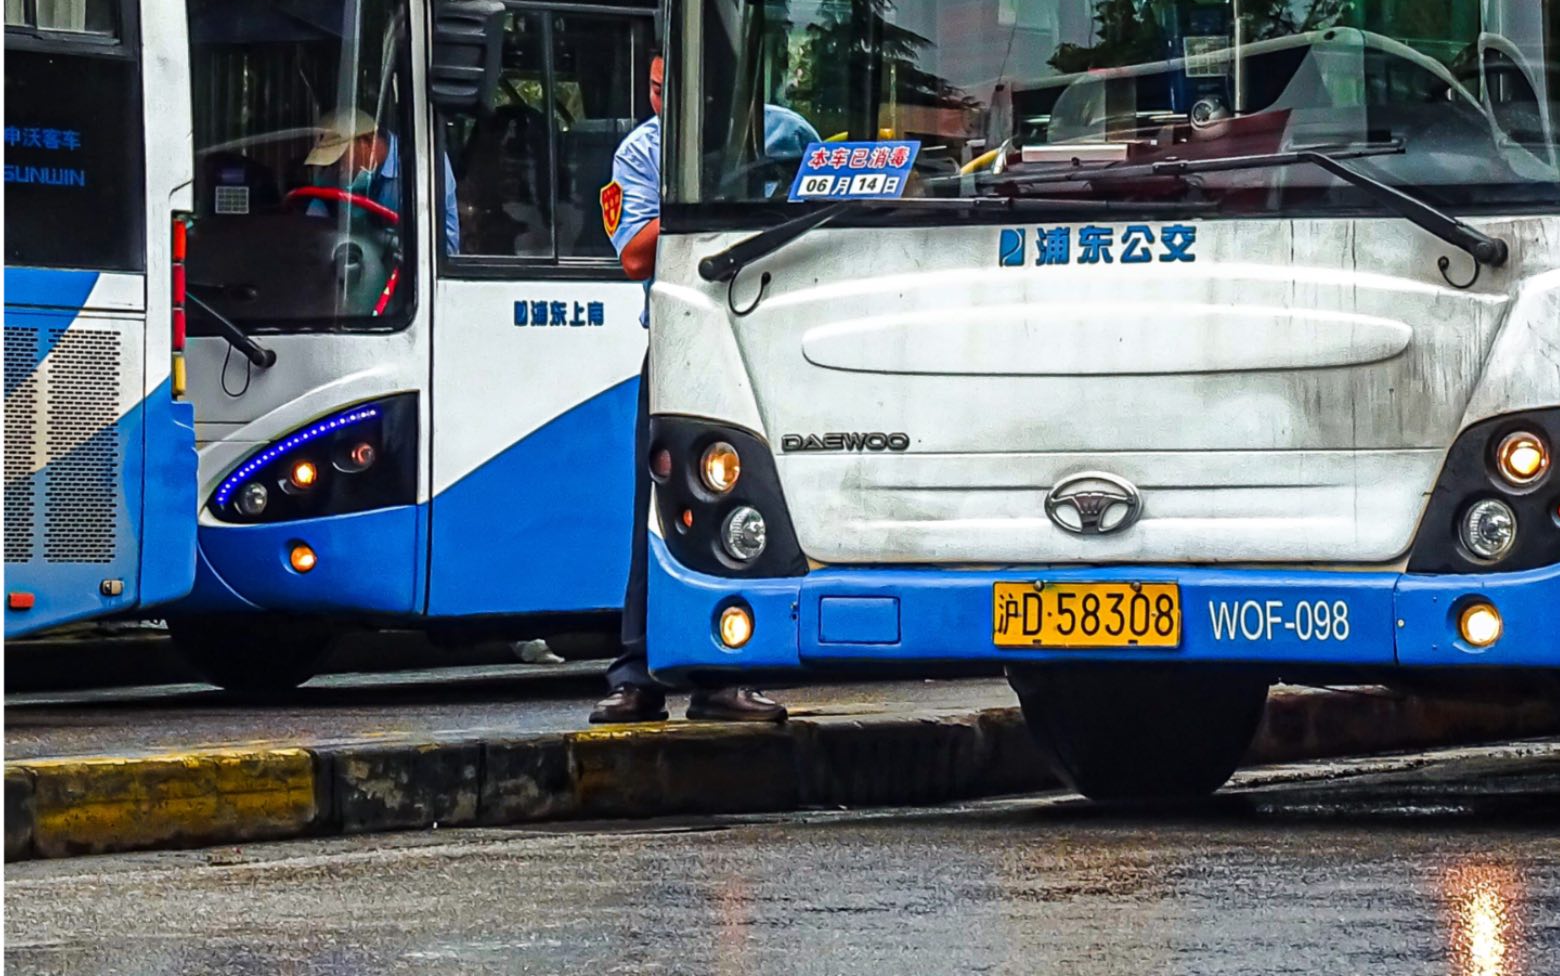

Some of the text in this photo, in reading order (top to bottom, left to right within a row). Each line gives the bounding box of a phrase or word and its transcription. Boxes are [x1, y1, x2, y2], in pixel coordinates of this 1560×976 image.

[809, 147, 910, 169] 本车已消毒
[4, 165, 85, 186] SUNWIN
[1036, 224, 1197, 266] 浦东公交
[781, 432, 910, 452] DAEWOO
